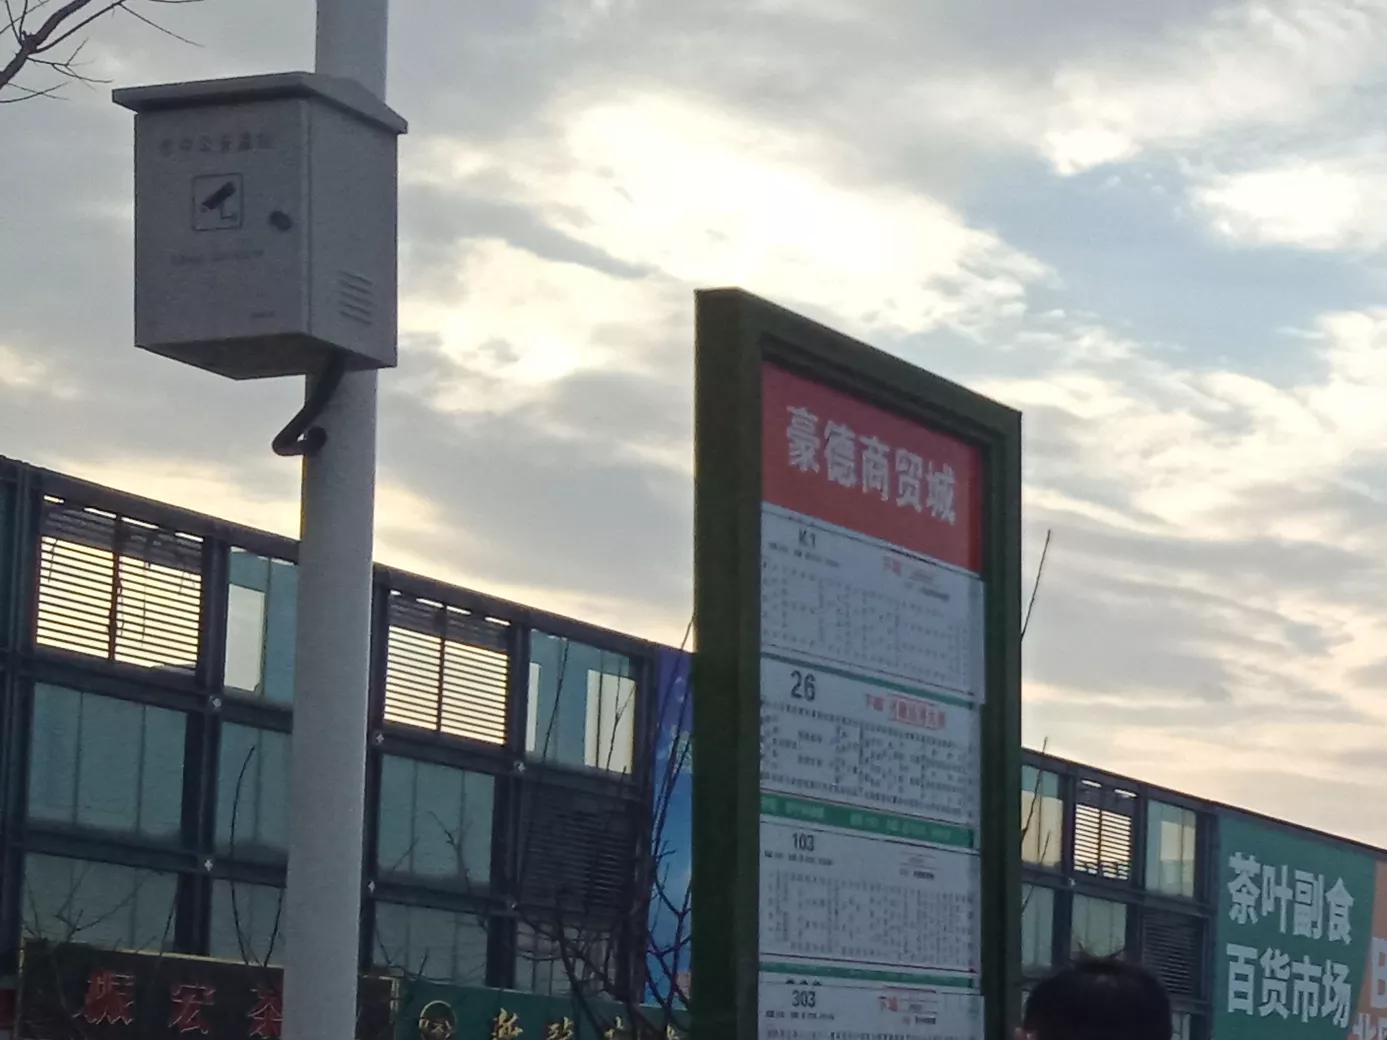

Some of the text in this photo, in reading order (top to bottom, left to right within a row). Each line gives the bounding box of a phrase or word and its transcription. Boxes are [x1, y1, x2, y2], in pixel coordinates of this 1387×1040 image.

[786, 405, 956, 526] 豪德商贸城
[790, 671, 816, 700] 26
[792, 832, 814, 852] 103
[1226, 851, 1355, 945] 茶叶副食
[791, 990, 816, 1008] 303
[1226, 942, 1352, 1029] 百货市场
